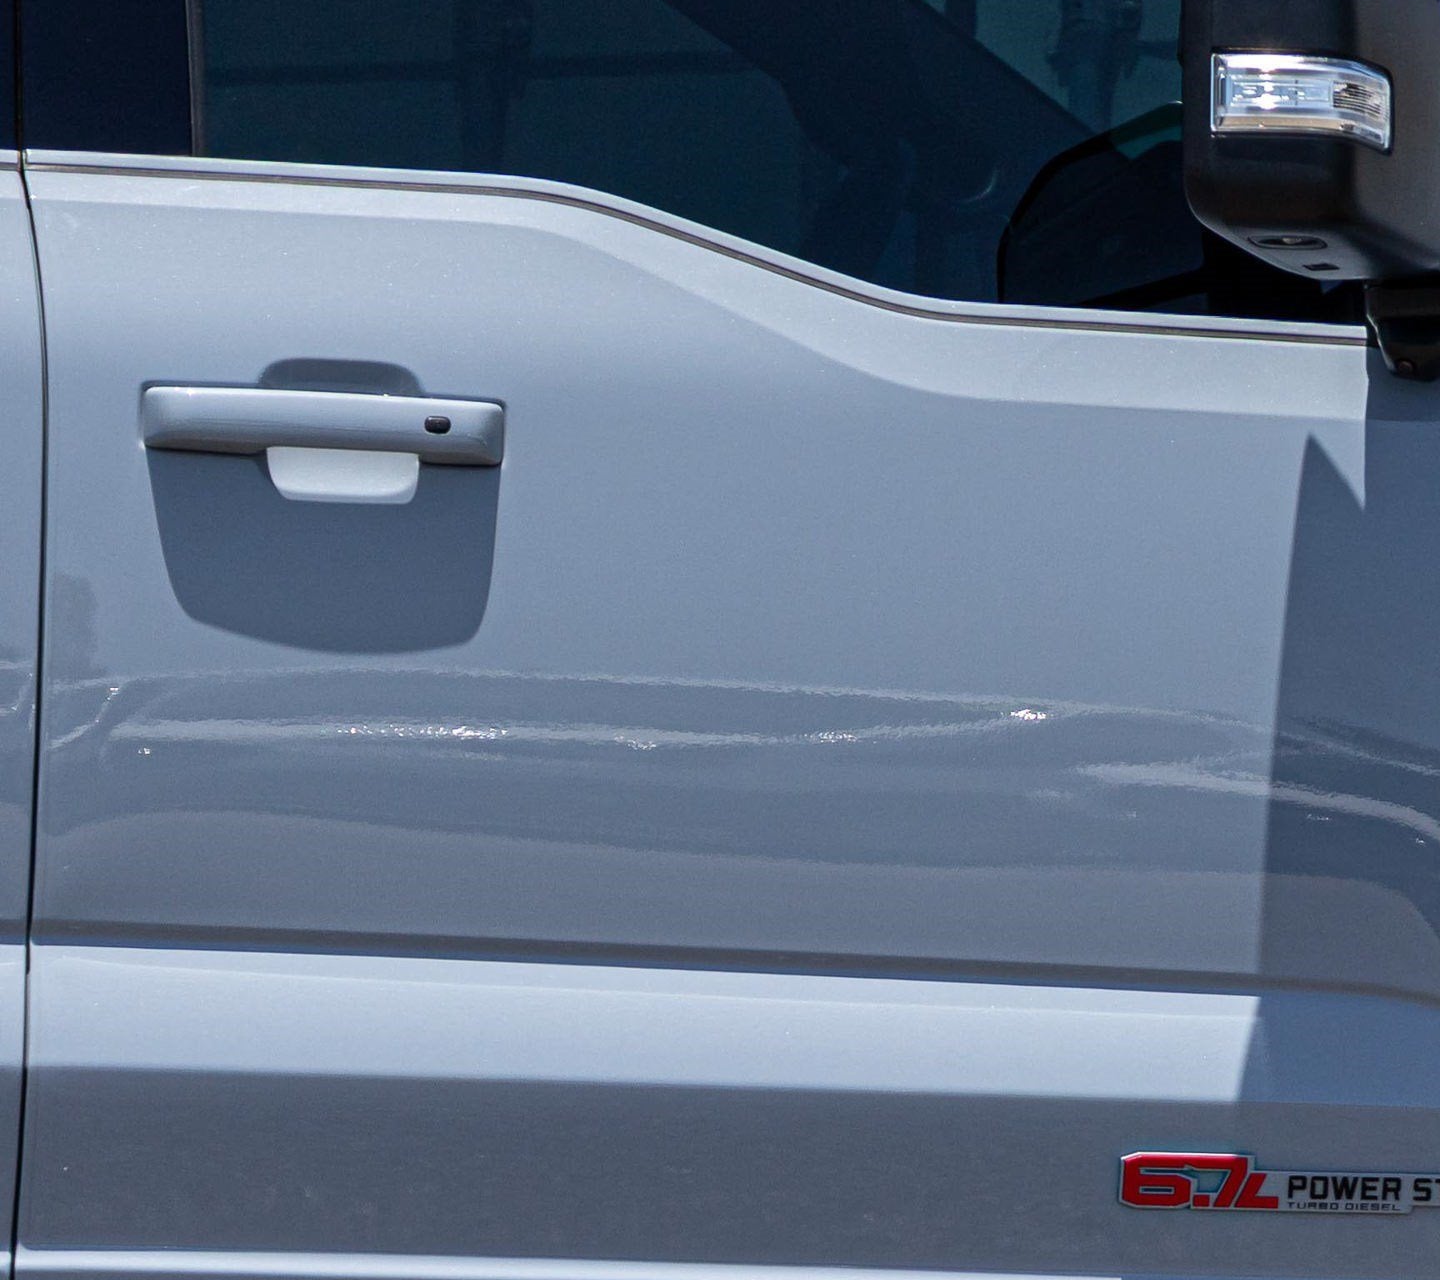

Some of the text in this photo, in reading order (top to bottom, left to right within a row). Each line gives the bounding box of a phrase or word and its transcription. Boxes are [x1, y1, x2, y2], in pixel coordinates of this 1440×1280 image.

[1120, 1152, 1280, 1210] 6.7L
[1287, 1175, 1401, 1202] POWER
[1287, 1202, 1400, 1212] TURBO DIESEL
